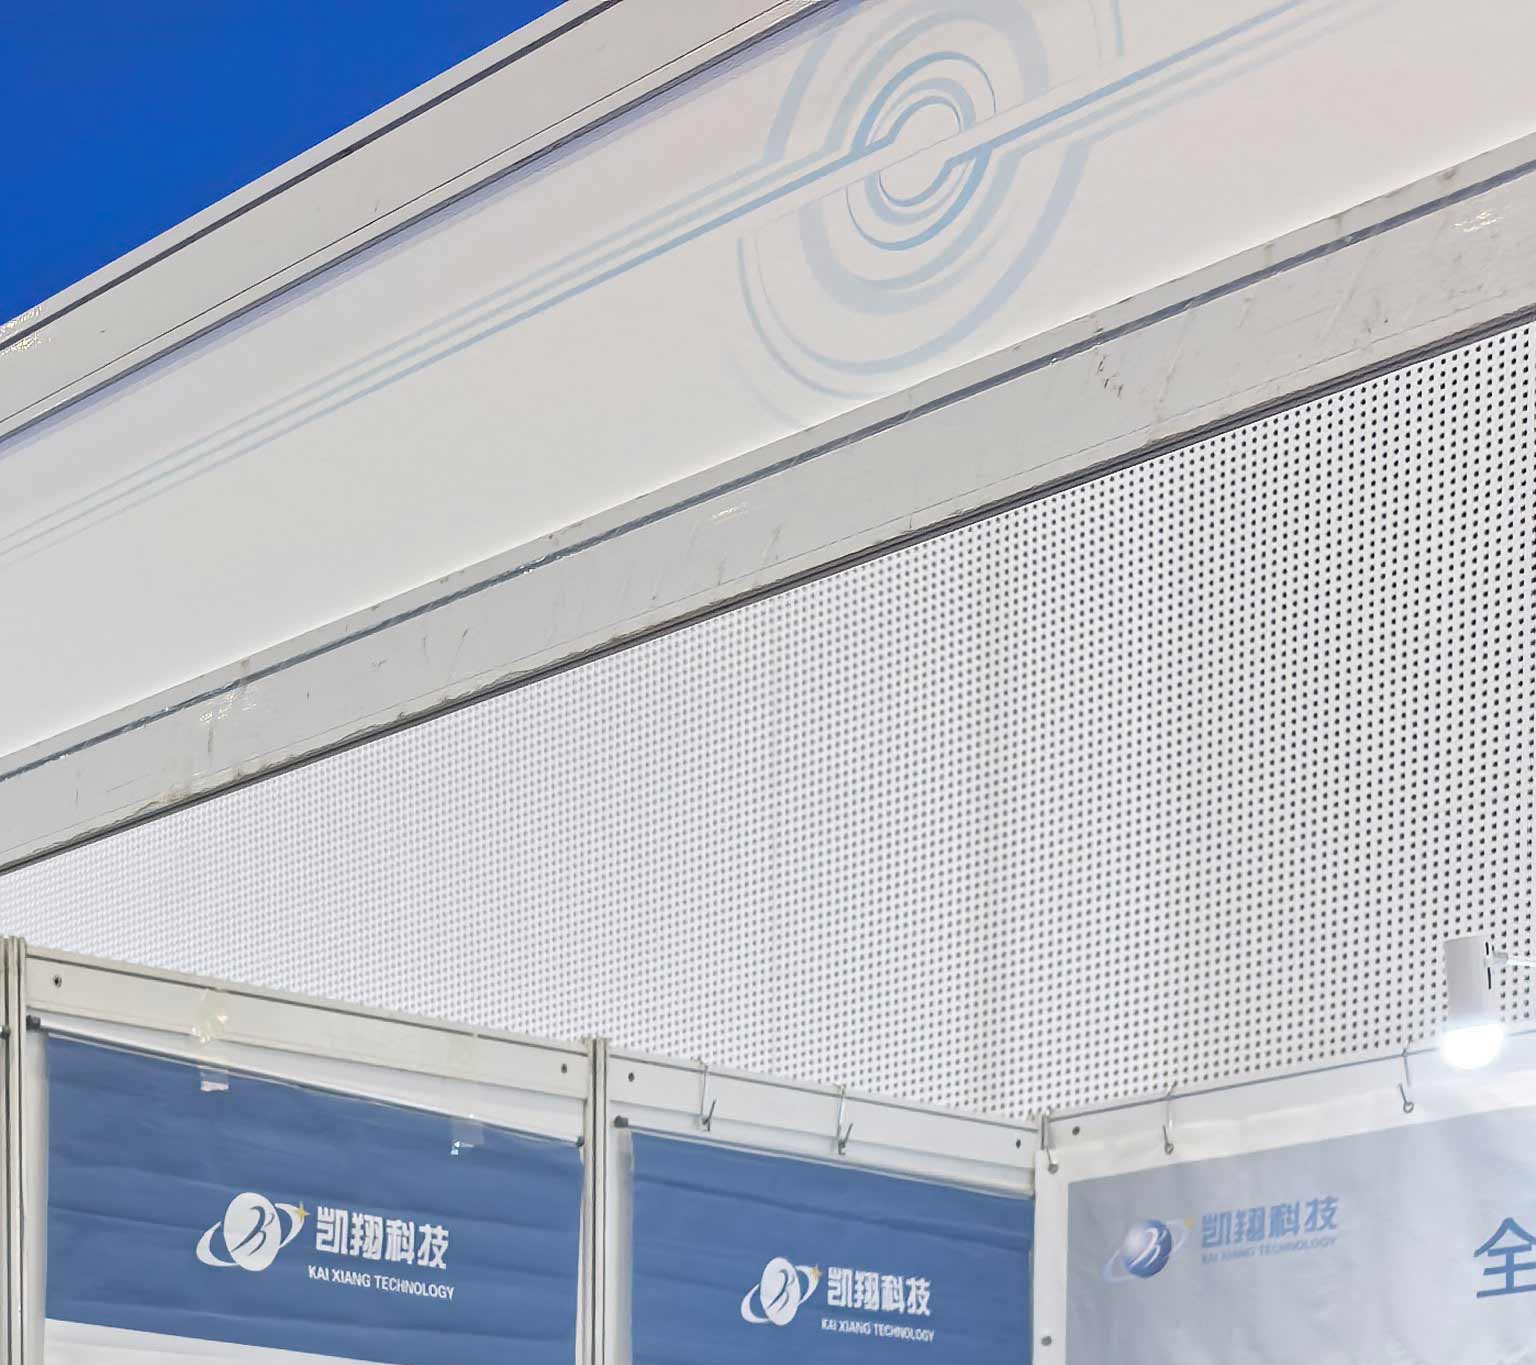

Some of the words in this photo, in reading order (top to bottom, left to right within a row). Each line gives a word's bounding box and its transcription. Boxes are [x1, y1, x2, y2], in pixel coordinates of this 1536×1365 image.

[316, 1206, 449, 1270] 凯翔科技
[1201, 1195, 1339, 1248] 凯翔科技
[308, 1265, 330, 1281] KAI
[332, 1268, 371, 1288] XIANG
[374, 1275, 454, 1300] TECHNOLOGY
[1473, 1216, 1536, 1299] 全
[827, 1266, 932, 1316] 凯翔科技
[821, 1319, 837, 1331] KAI
[839, 1320, 871, 1336] XIANG
[874, 1324, 935, 1343] TECHNOLOGY
